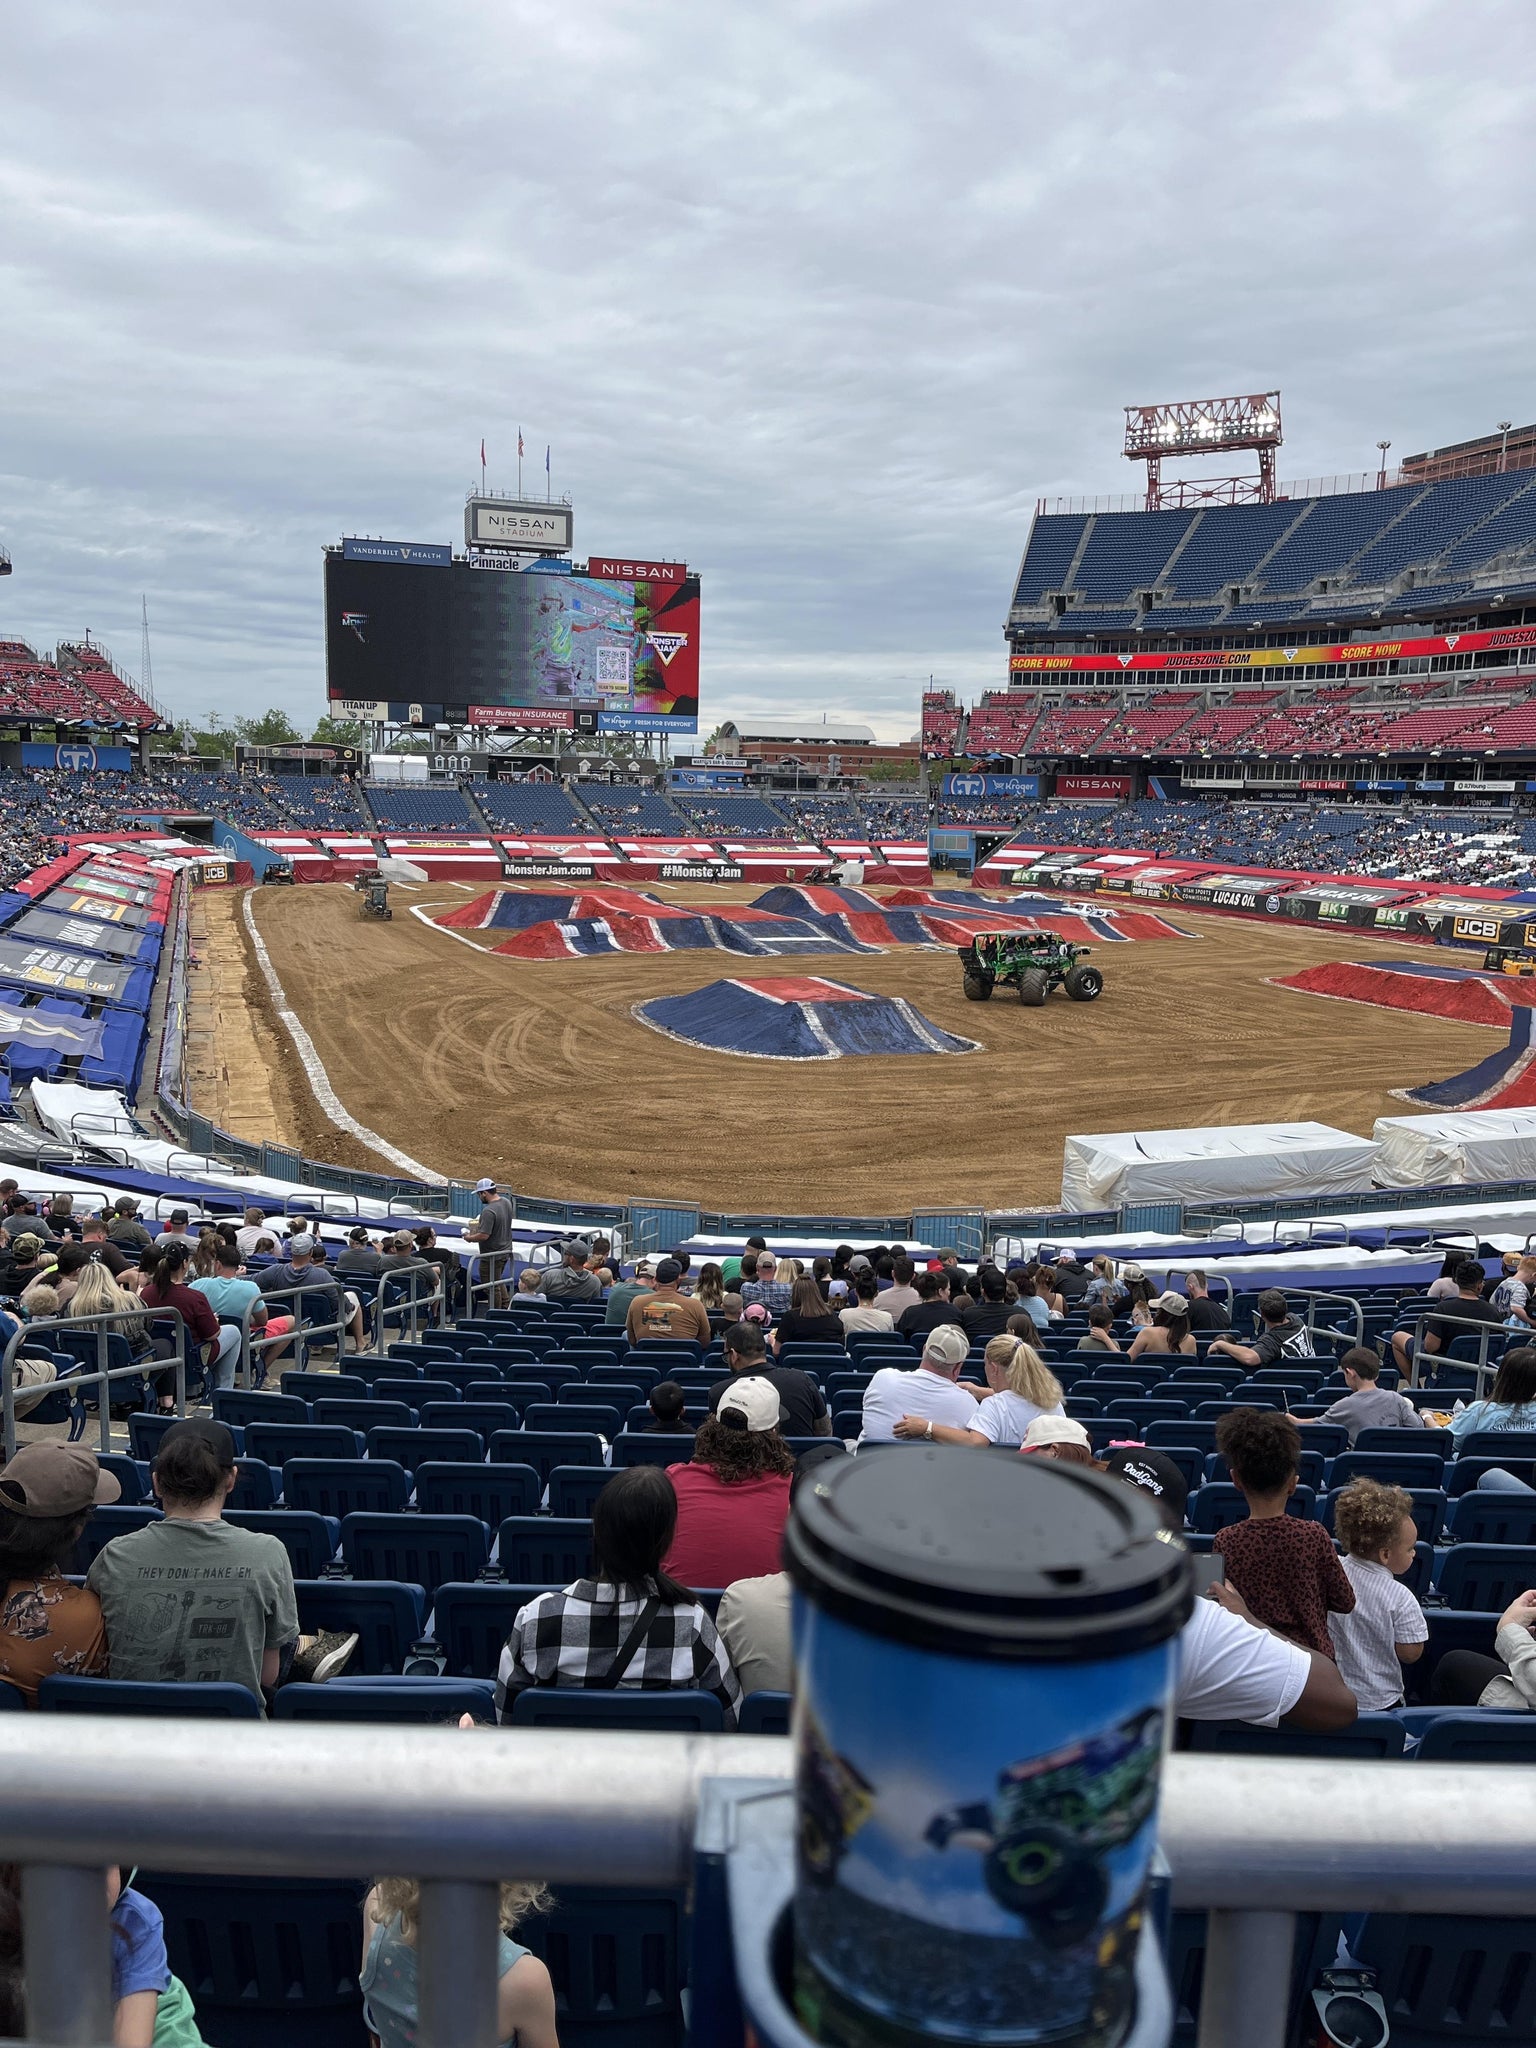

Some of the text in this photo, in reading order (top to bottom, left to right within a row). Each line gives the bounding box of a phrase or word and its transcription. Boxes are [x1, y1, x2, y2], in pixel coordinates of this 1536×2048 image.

[489, 516, 554, 529] NISSAN
[500, 528, 543, 537] STADIUM
[353, 547, 398, 556] VANDERBILT
[412, 551, 441, 559] HEALTH
[471, 555, 519, 570] Pinnacle
[602, 564, 673, 578] NISSAN
[646, 637, 688, 646] MONSTER
[1340, 643, 1402, 659] SCORE NOW!
[1011, 658, 1073, 668] SCORE NOW!
[1163, 653, 1251, 666] JUDGESZONE.COM
[341, 701, 377, 710] TITAN UP
[475, 708, 567, 720] Farm Bureau INSURANCE
[611, 715, 632, 728] Kroger
[1005, 778, 1034, 795] Kroger
[1065, 779, 1121, 789] NISSAN
[205, 866, 225, 879] JCB
[505, 864, 592, 876] MonsterJam.com
[1195, 888, 1211, 896] SPORTS
[1212, 891, 1240, 906] LUCAS
[1241, 894, 1256, 907] OIL
[1319, 901, 1349, 916] BKT
[1376, 908, 1408, 922] BKT
[1457, 920, 1497, 937] JCB
[1123, 1462, 1164, 1496] DadGang
[137, 1567, 252, 1580] THEY DON'T MAKE 'EM
